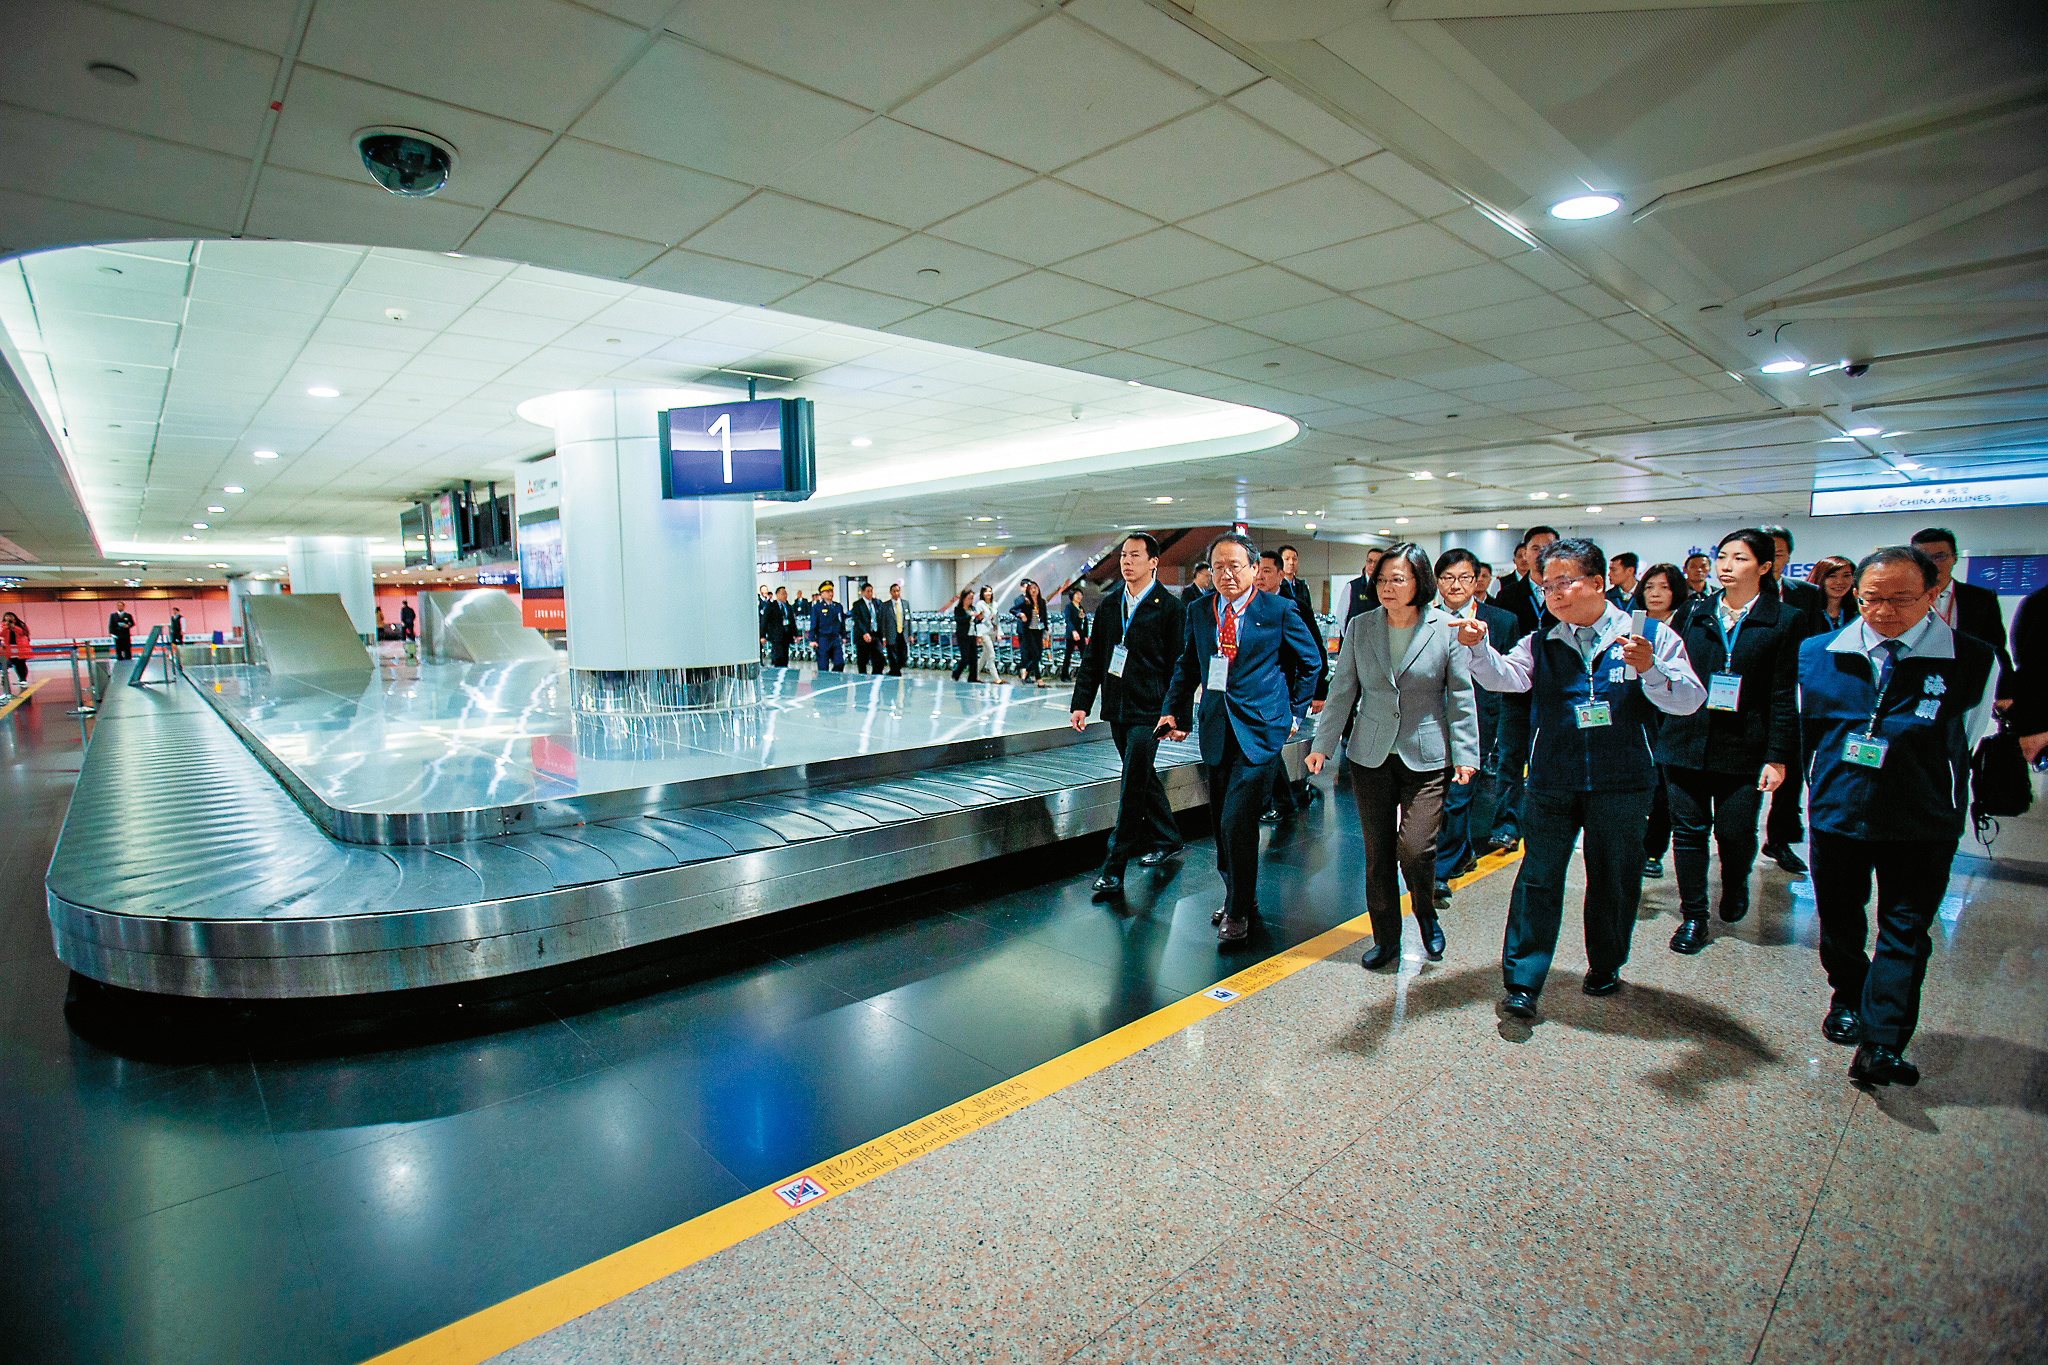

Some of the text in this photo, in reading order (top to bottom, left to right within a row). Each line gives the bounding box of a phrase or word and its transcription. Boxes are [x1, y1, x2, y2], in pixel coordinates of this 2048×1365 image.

[707, 413, 733, 484] 1
[1899, 494, 1992, 506] CHINA AIRLINES
[830, 1095, 1030, 1189] No trolley beyond the yellow line
